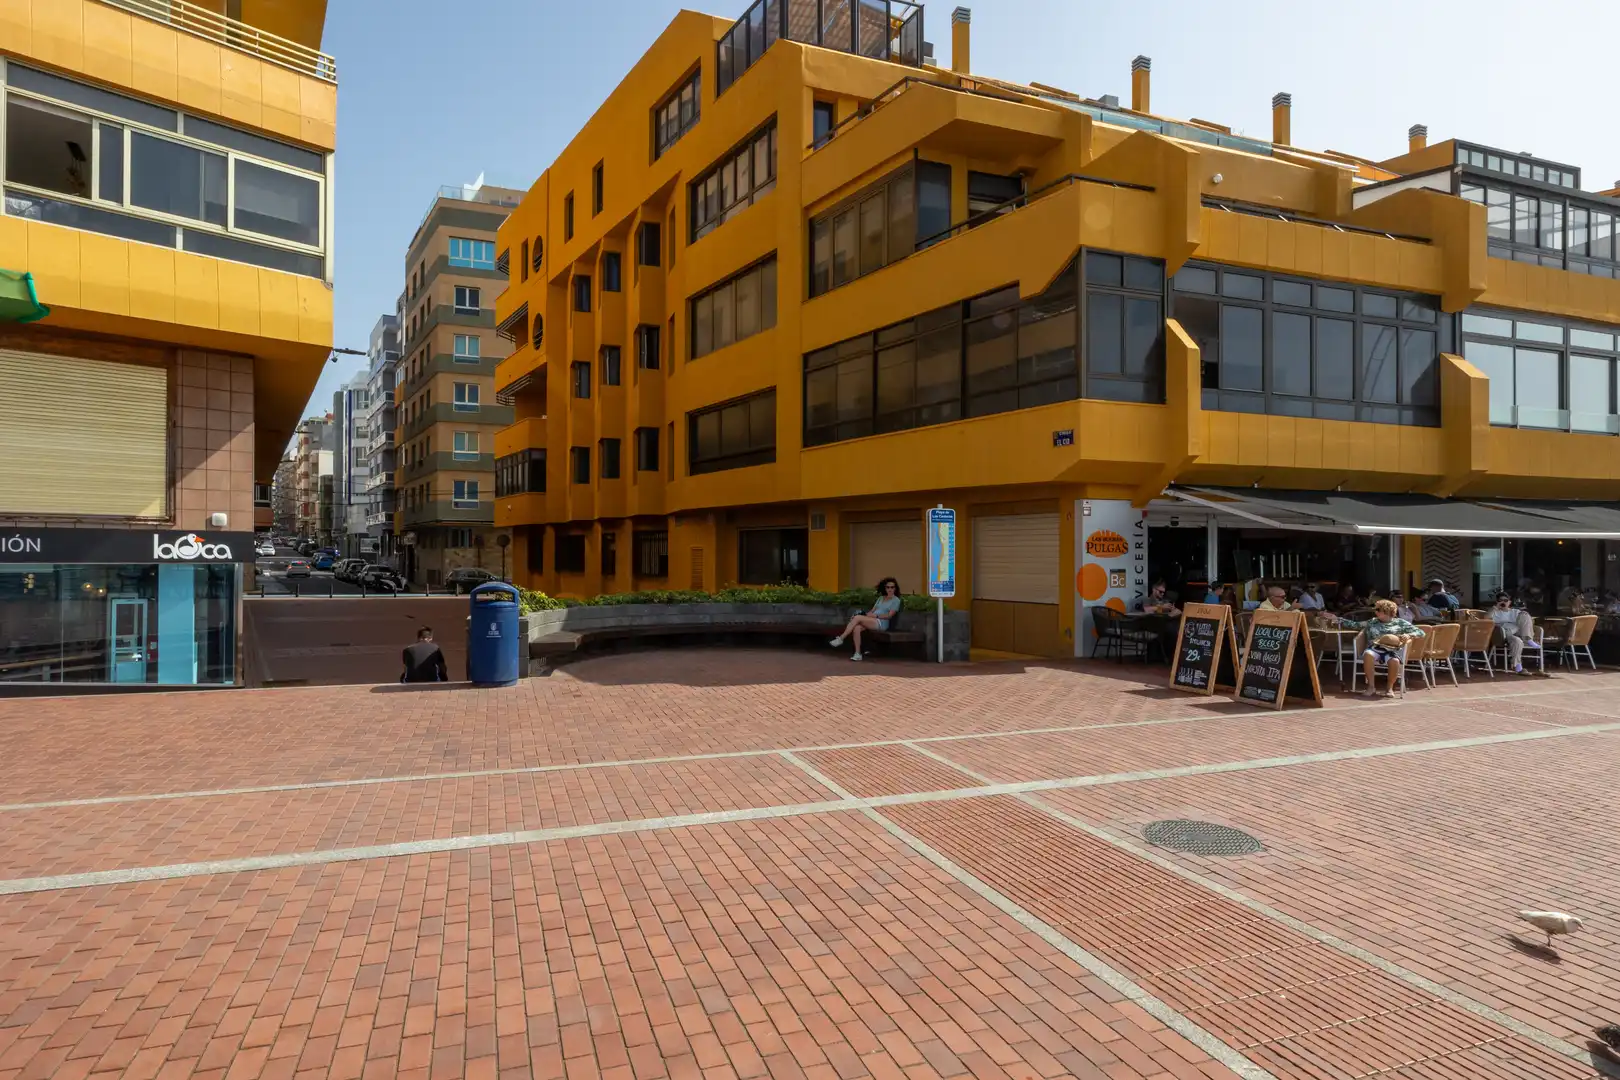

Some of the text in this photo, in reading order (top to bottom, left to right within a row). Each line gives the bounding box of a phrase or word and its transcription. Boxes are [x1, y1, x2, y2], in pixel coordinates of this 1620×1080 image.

[1086, 541, 1129, 555] PULGAS
[1255, 626, 1271, 637] LOCAL
[1258, 639, 1280, 650] BEERS
